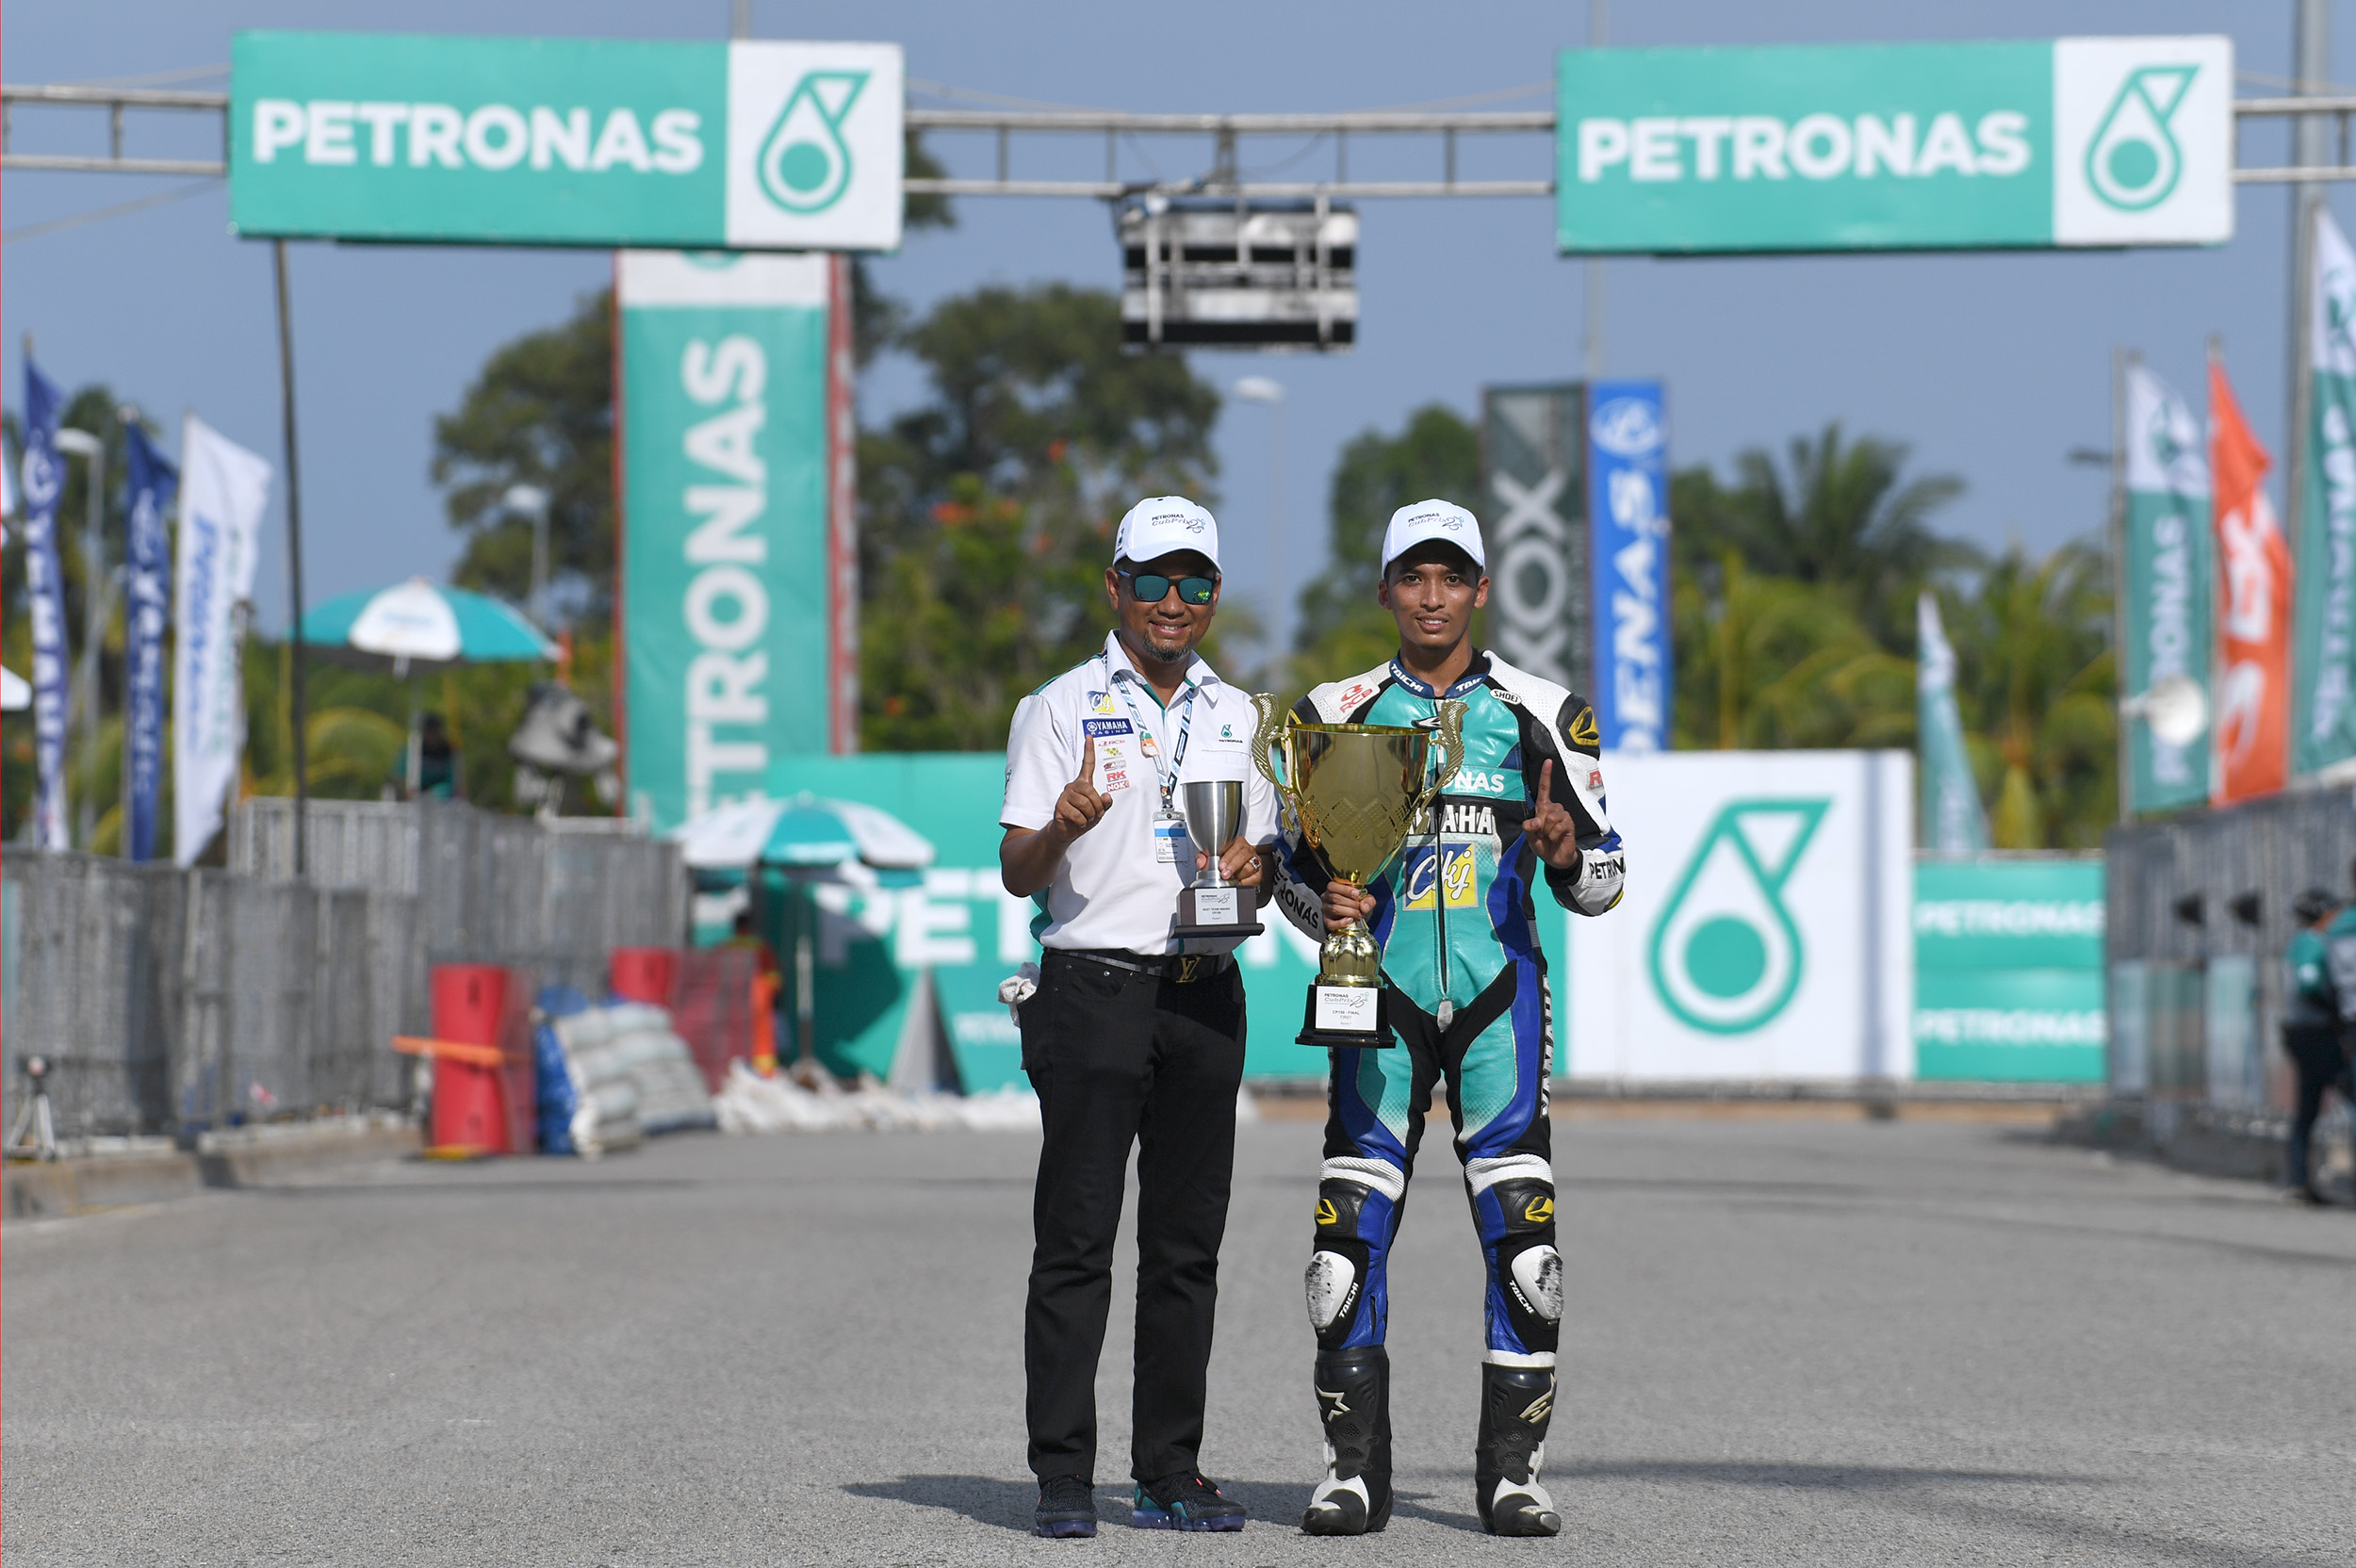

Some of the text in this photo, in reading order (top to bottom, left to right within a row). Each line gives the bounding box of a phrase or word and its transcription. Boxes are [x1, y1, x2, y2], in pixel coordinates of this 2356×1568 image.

[252, 99, 704, 173] PETRONAS
[1577, 111, 2032, 182] PETRONAS
[681, 333, 769, 816] TRONAS
[1390, 663, 1424, 693] TAICHI
[1455, 677, 1483, 693] TAI
[1494, 691, 1518, 703] SHOEI
[1096, 721, 1128, 731] YAMAHA
[1106, 770, 1126, 781] RK
[1107, 782, 1126, 792] NGK
[1589, 857, 1626, 880] PETRON
[1338, 1282, 1359, 1318] TAICHI
[1509, 1280, 1534, 1315] TAICHI
